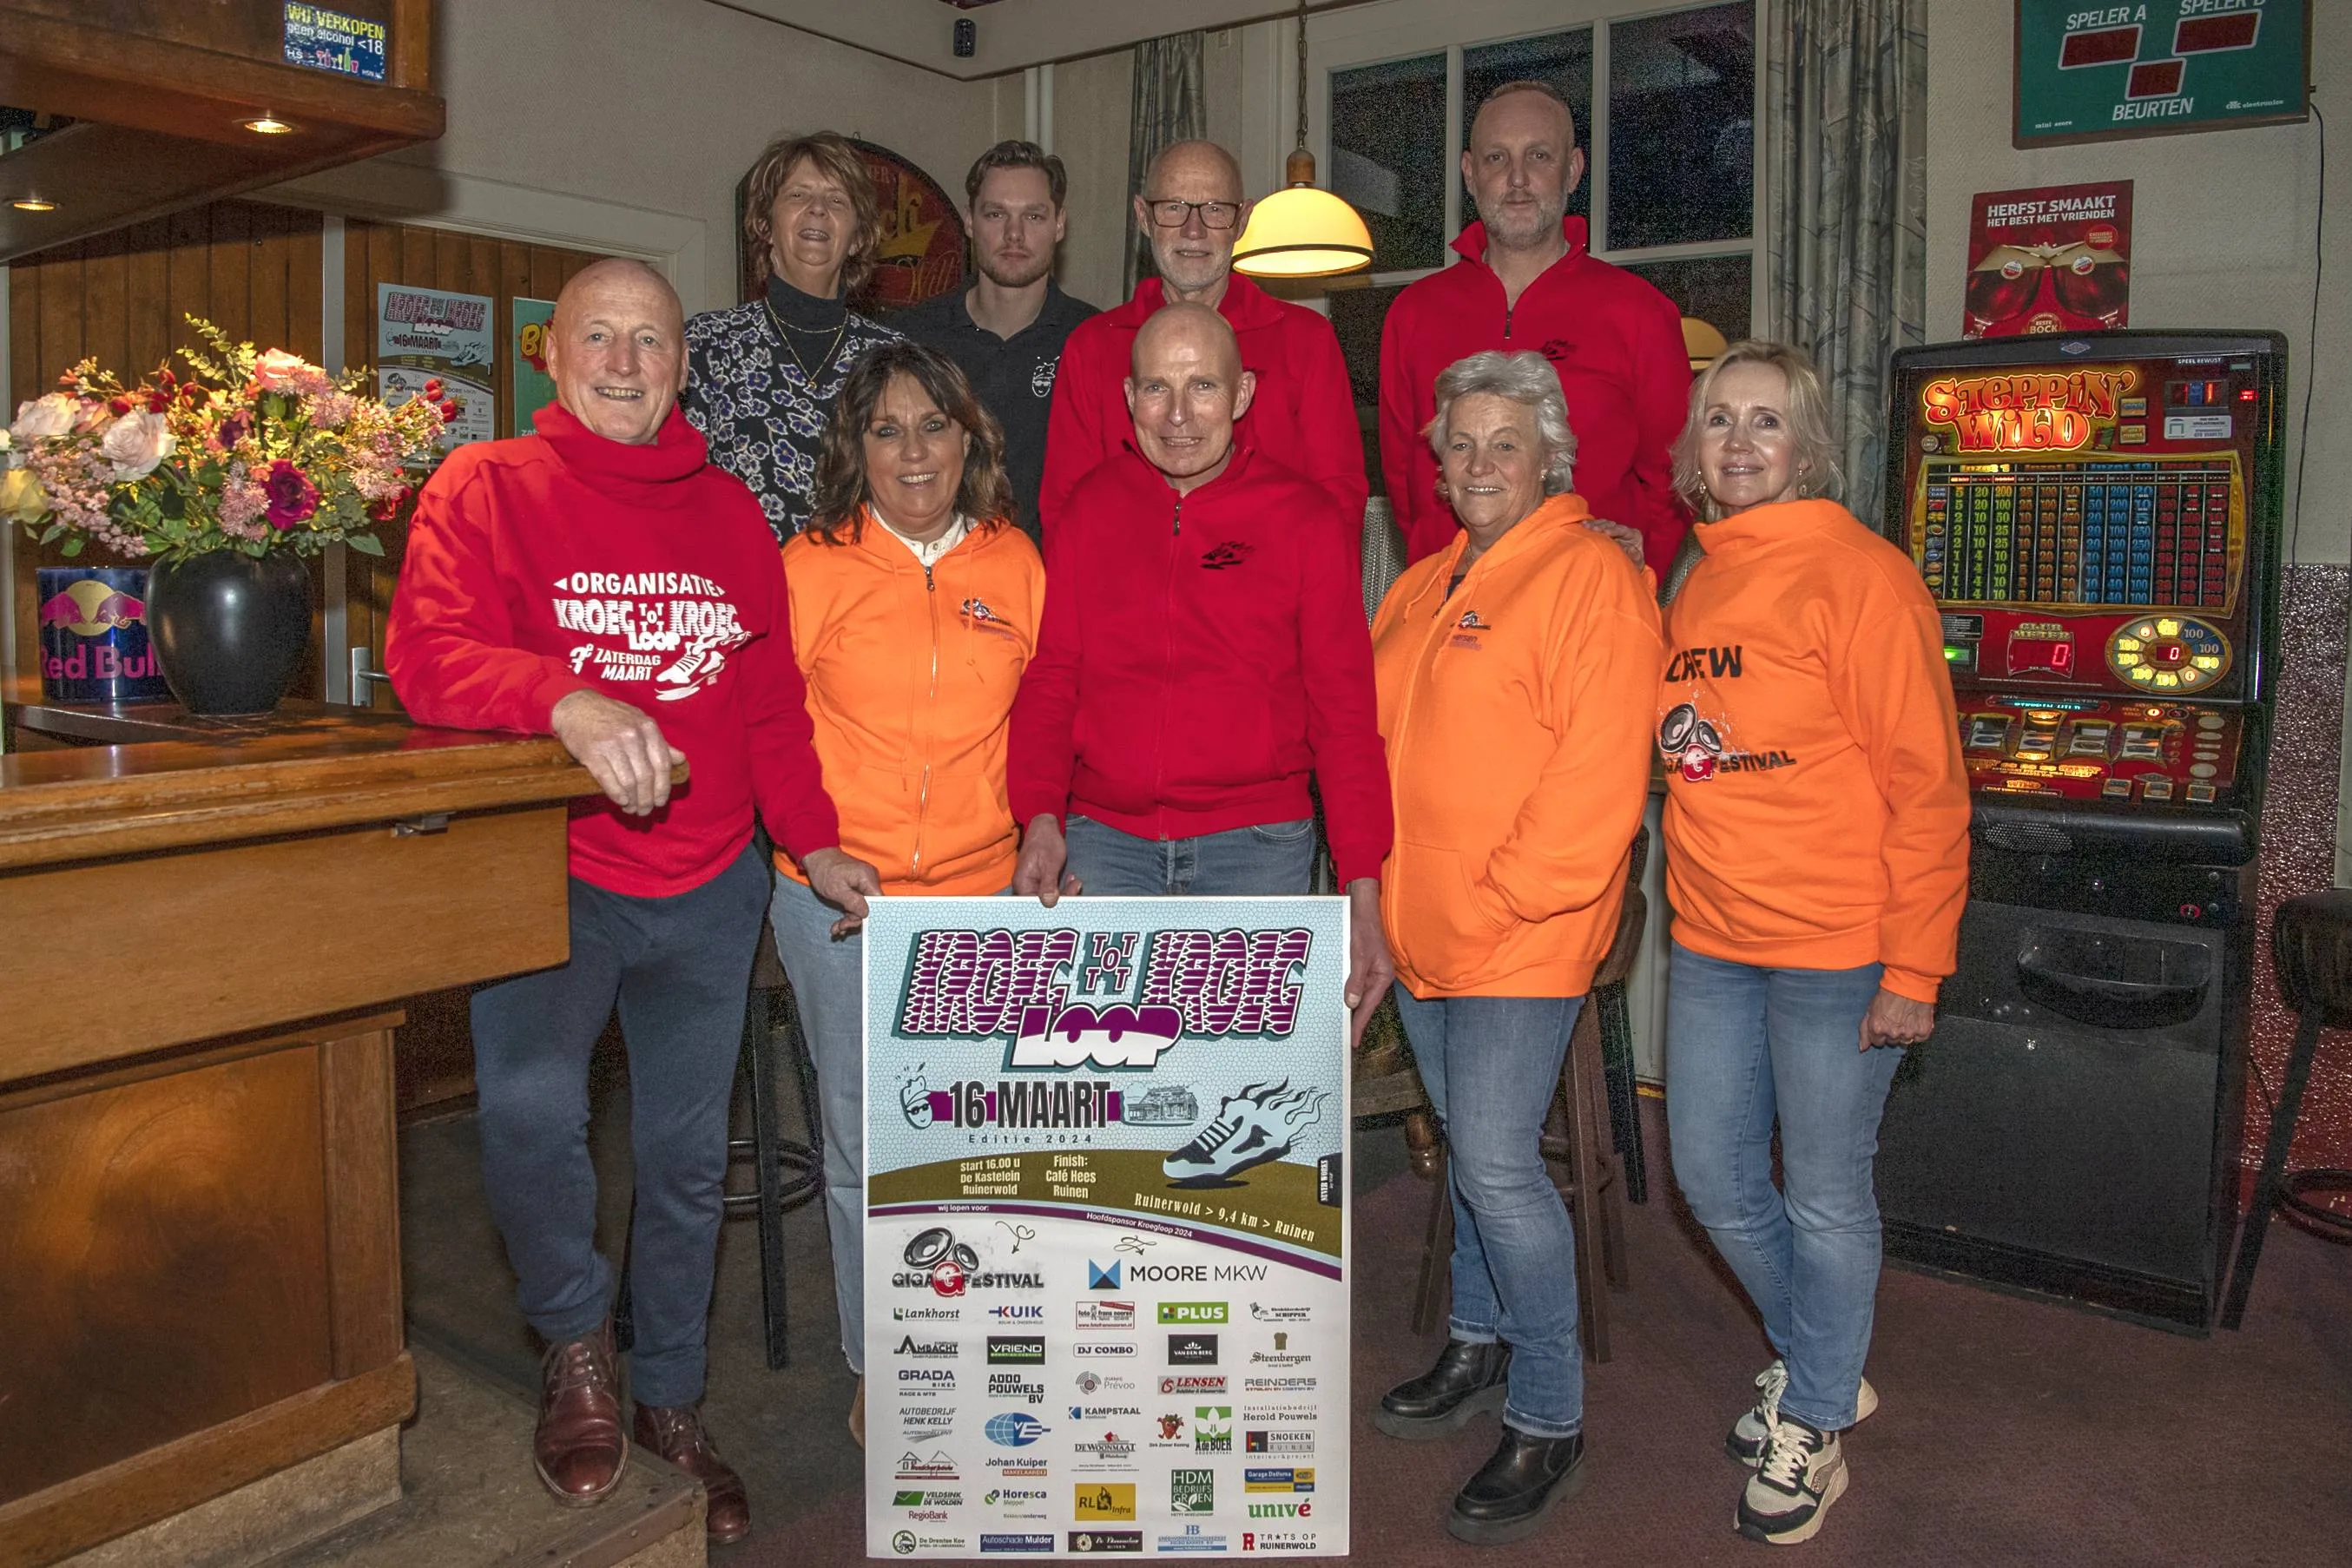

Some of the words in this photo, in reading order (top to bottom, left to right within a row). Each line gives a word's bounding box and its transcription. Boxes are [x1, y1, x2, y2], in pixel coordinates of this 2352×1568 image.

[2066, 6, 2131, 30] SPELER
[2135, 4, 2146, 22] A
[316, 10, 383, 40] VERKOPEN
[287, 23, 313, 37] geen
[317, 29, 354, 47] alcohol
[357, 38, 383, 55] <18
[2112, 98, 2193, 121] BEURTEN
[1987, 201, 2046, 217] HERFST
[2049, 195, 2116, 212] SMAAKT
[1986, 217, 2006, 227] HET
[2009, 215, 2035, 226] BEST
[2037, 214, 2059, 223] MET
[2061, 209, 2115, 221] VRIENDEN
[2030, 325, 2058, 333] BOCK
[1955, 486, 1964, 497] 5
[1975, 486, 1989, 497] 20
[1954, 499, 1963, 510] 5
[1974, 499, 1988, 510] 20
[1996, 499, 2011, 510] 100
[1954, 512, 1963, 522] 2
[1974, 512, 1986, 522] 10
[1997, 512, 2010, 522] 50
[570, 572, 720, 596] ORGANISATIE
[552, 599, 635, 635] KROEG
[669, 600, 743, 636] KROEG
[2184, 629, 2204, 638] 100
[629, 631, 681, 650] LOOP
[594, 648, 661, 665] ZATERDAG
[2052, 644, 2069, 665] 0
[2170, 648, 2179, 660] 0
[2199, 644, 2218, 653] 100
[95, 642, 162, 679] Bul
[1665, 644, 1743, 682] CREW
[601, 664, 652, 681] MAART
[1711, 750, 1796, 773] FESTIVAL
[1011, 1005, 1182, 1067] LOOP
[948, 1080, 986, 1129] 16
[997, 1080, 1110, 1129] MAART
[969, 1135, 1031, 1143] Editie
[1046, 1135, 1091, 1143] 2024
[986, 1157, 1011, 1169] 16.00
[1014, 1158, 1021, 1168] u
[1054, 1155, 1088, 1167] Finish:
[960, 1174, 972, 1183] De
[975, 1170, 1020, 1183] Kastelein
[1045, 1169, 1067, 1182] Café
[1071, 1170, 1096, 1183] Hees
[963, 1184, 1018, 1195] Ruinerwold
[1053, 1184, 1088, 1199] Ruinen
[1135, 1193, 1200, 1216] Ruinerwold
[1219, 1208, 1236, 1223] 9,4
[1241, 1212, 1257, 1228] km
[1275, 1220, 1315, 1242] Ruinen
[1086, 1212, 1136, 1227] Hoofdsponsor
[1137, 1221, 1173, 1235] Kroegloop
[1174, 1228, 1193, 1238] 2024
[1130, 1266, 1208, 1281] MOORE
[1215, 1265, 1268, 1281] MKW
[963, 1273, 1044, 1288] FESTIVAL
[905, 1308, 959, 1319] Lankhorst
[998, 1306, 1044, 1317] KUIK
[1177, 1307, 1224, 1320] PLUS
[1250, 1352, 1311, 1364] Steenbergen
[899, 1370, 954, 1380] GRADA
[989, 1374, 1021, 1383] ADDO
[989, 1384, 1044, 1393] POUWELS
[1104, 1380, 1135, 1389] Prévoo
[1177, 1377, 1225, 1387] LENSEN
[1245, 1378, 1316, 1387] REINDERS
[1029, 1394, 1044, 1403] BV
[1087, 1443, 1136, 1452] WOONMAAT
[1196, 1438, 1202, 1451] A
[1202, 1442, 1210, 1451] de
[1210, 1438, 1232, 1451] BOER
[985, 1458, 1016, 1466] Johan
[1017, 1458, 1047, 1467] Kuiper
[1174, 1472, 1211, 1484] HDM
[1003, 1490, 1046, 1499] Horesca
[1173, 1493, 1211, 1503] GREN
[1079, 1497, 1095, 1508] RL
[1248, 1498, 1311, 1518] univé
[908, 1511, 948, 1521] RegioBank
[982, 1535, 1024, 1544] Autoschade
[1025, 1535, 1052, 1544] Mulder
[1242, 1532, 1255, 1551] R
